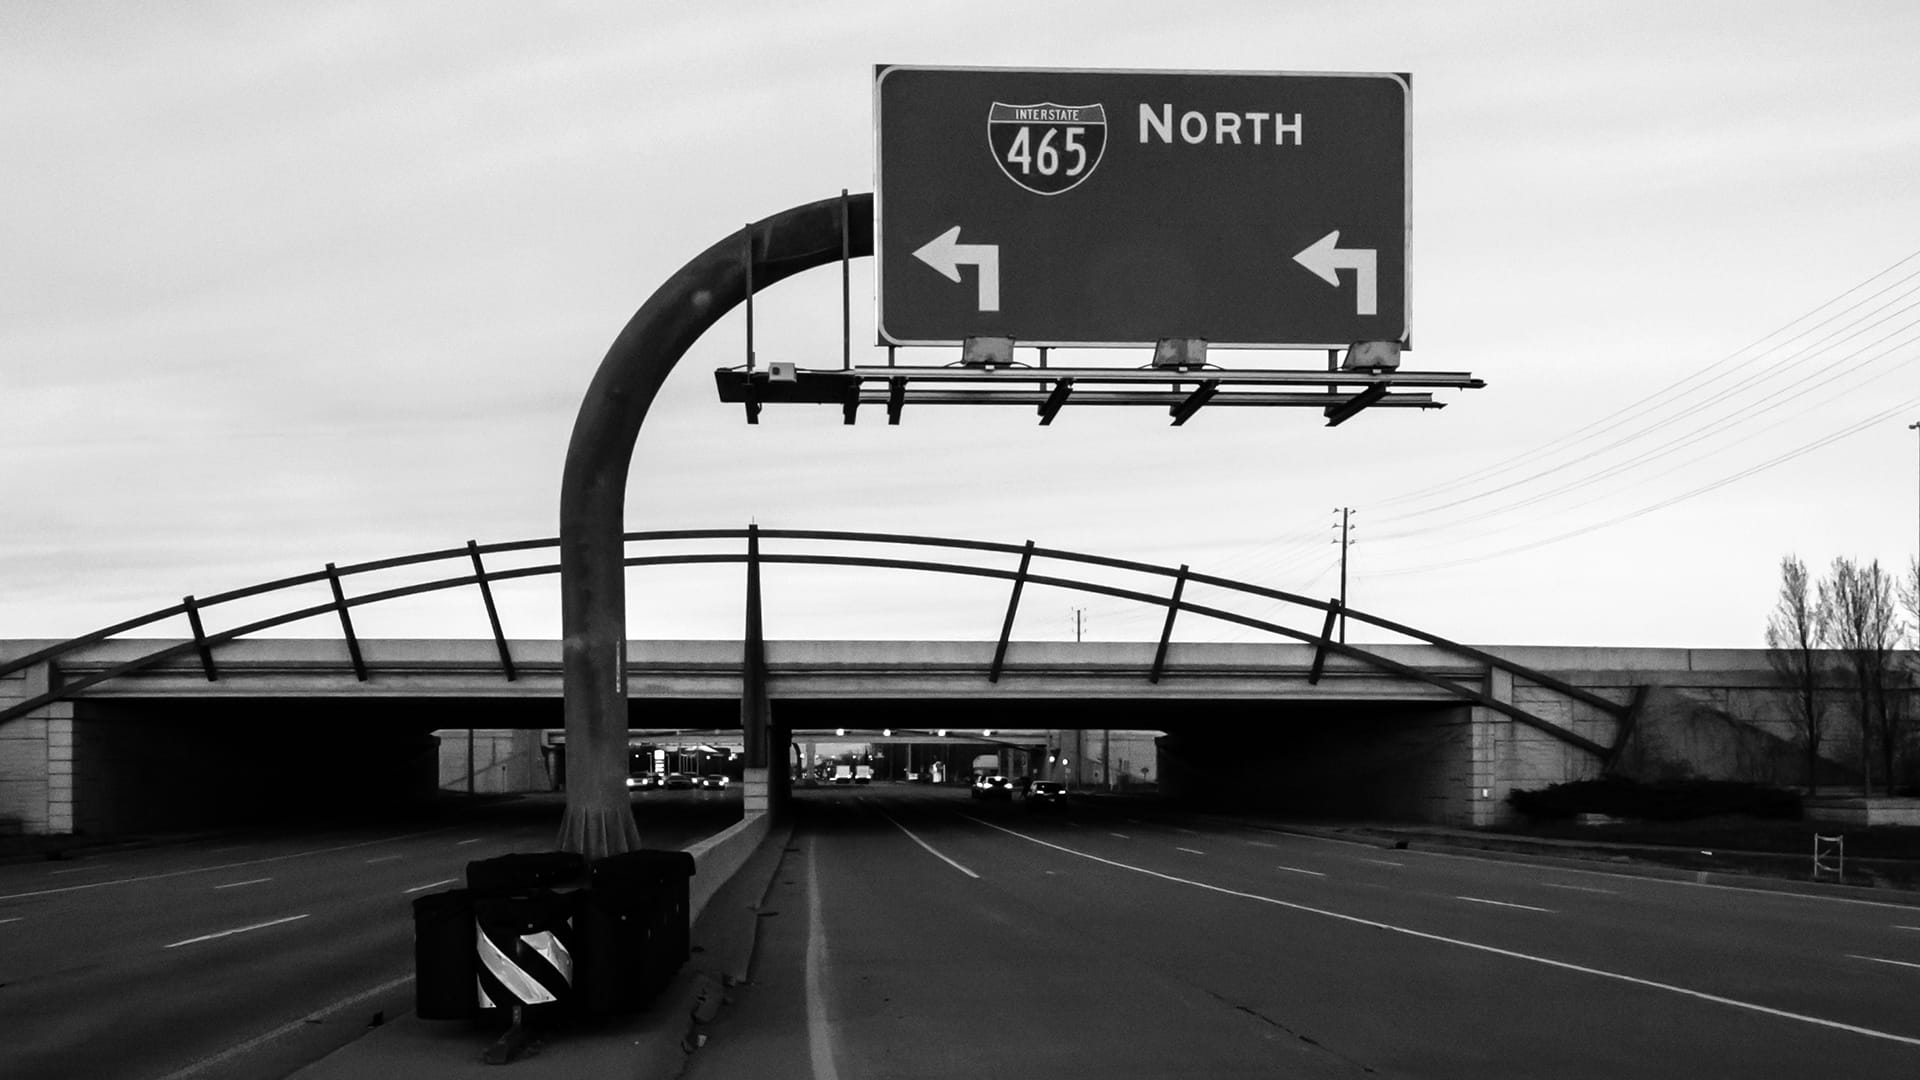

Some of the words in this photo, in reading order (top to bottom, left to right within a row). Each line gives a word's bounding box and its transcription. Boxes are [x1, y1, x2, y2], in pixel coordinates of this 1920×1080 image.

[1015, 108, 1079, 121] INTERSTATE
[1139, 103, 1302, 145] NORTH
[1007, 126, 1086, 176] 465
